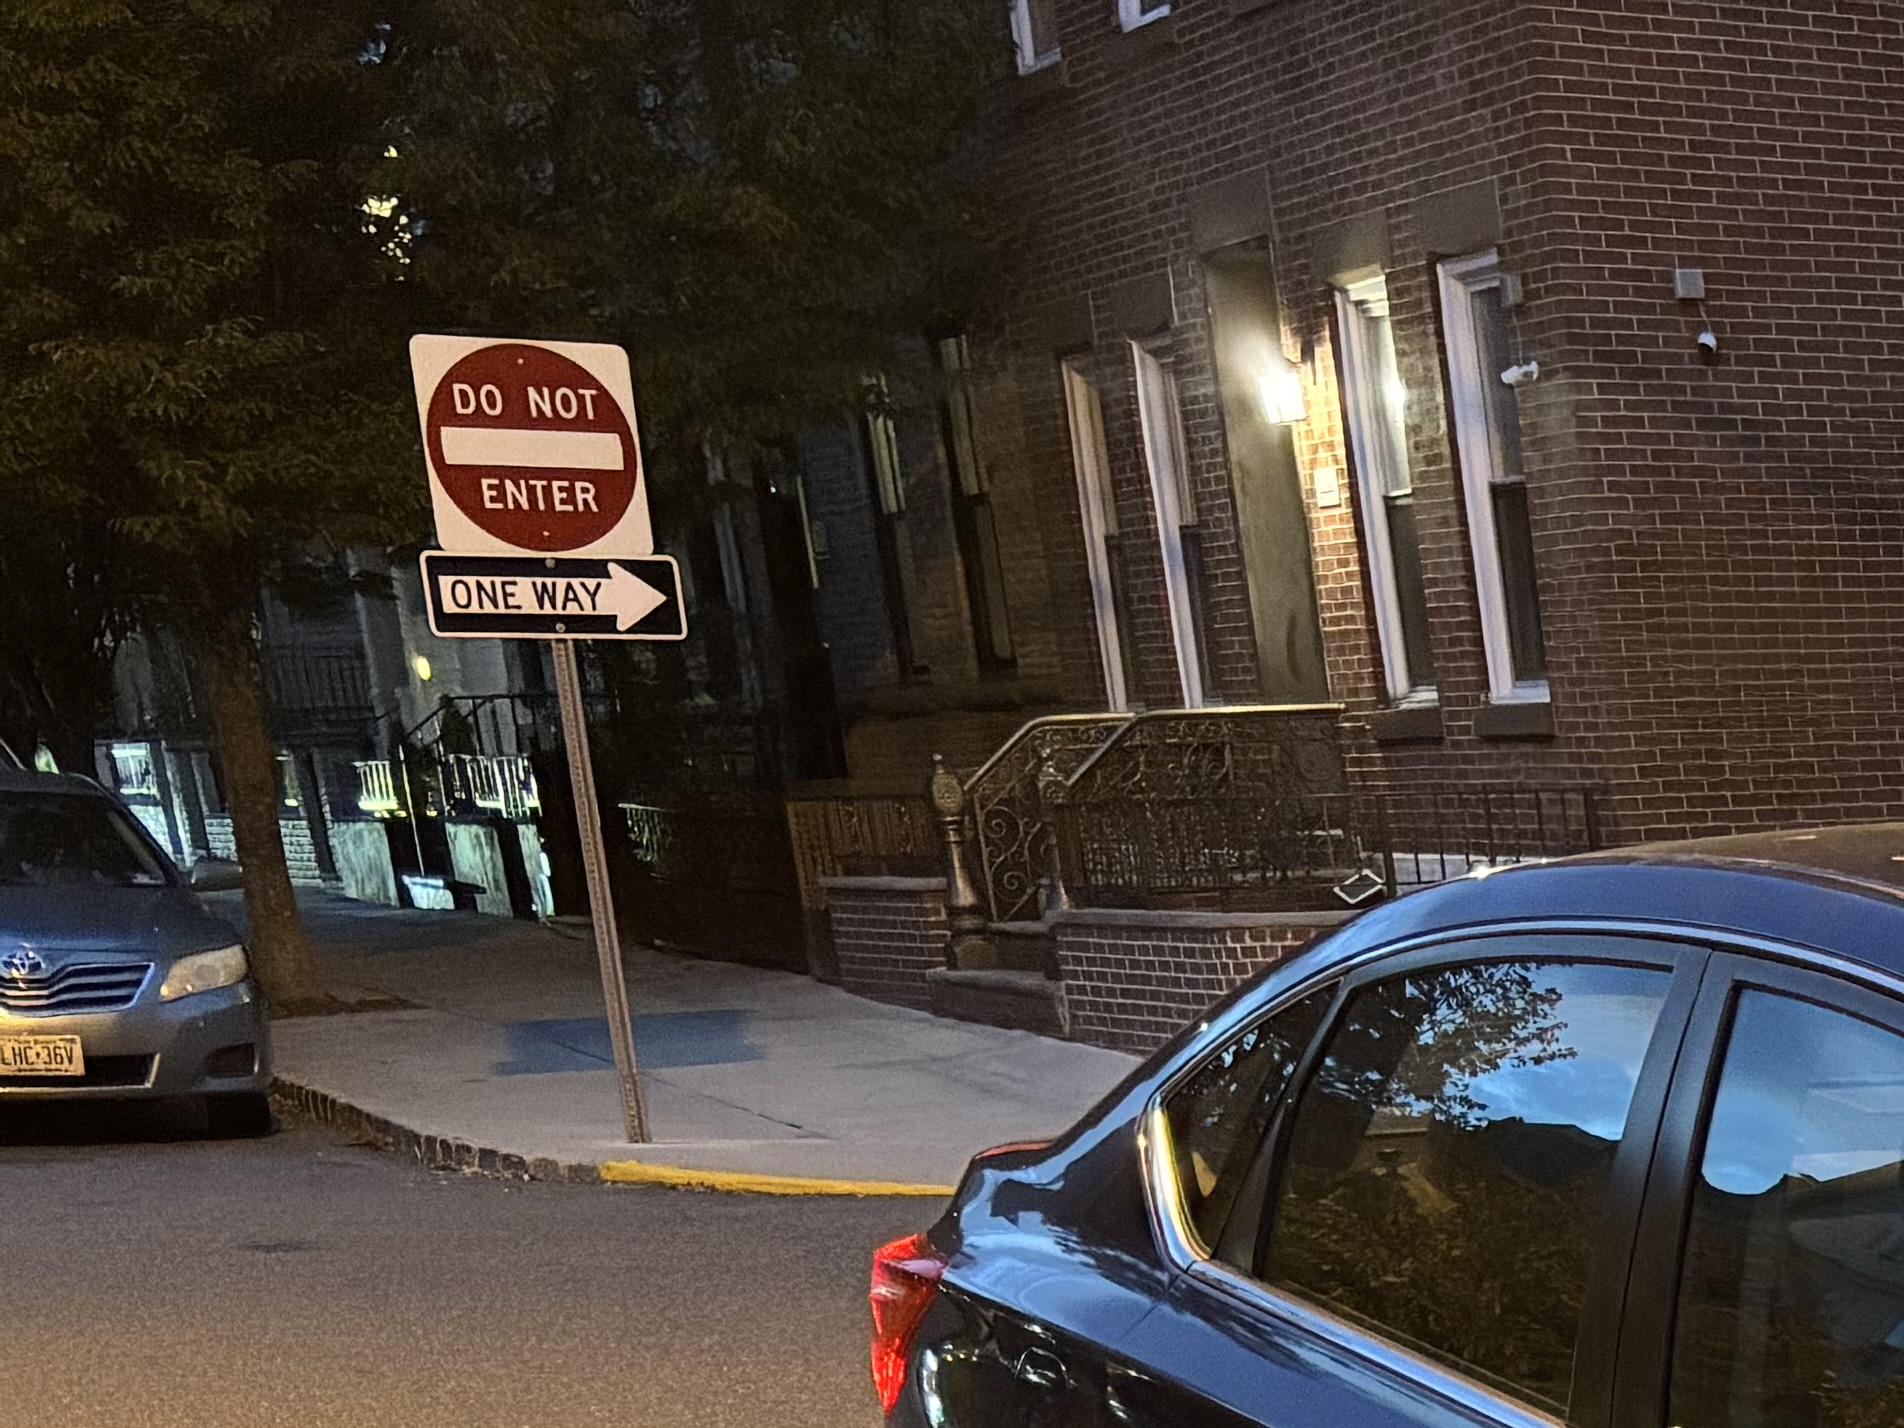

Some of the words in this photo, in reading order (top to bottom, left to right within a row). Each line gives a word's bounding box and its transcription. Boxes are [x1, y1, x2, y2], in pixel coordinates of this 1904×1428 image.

[452, 382, 503, 417] DO
[527, 385, 599, 421] NOT
[480, 478, 599, 513] ENTER
[450, 579, 522, 611] ONE
[531, 581, 602, 612] WAY
